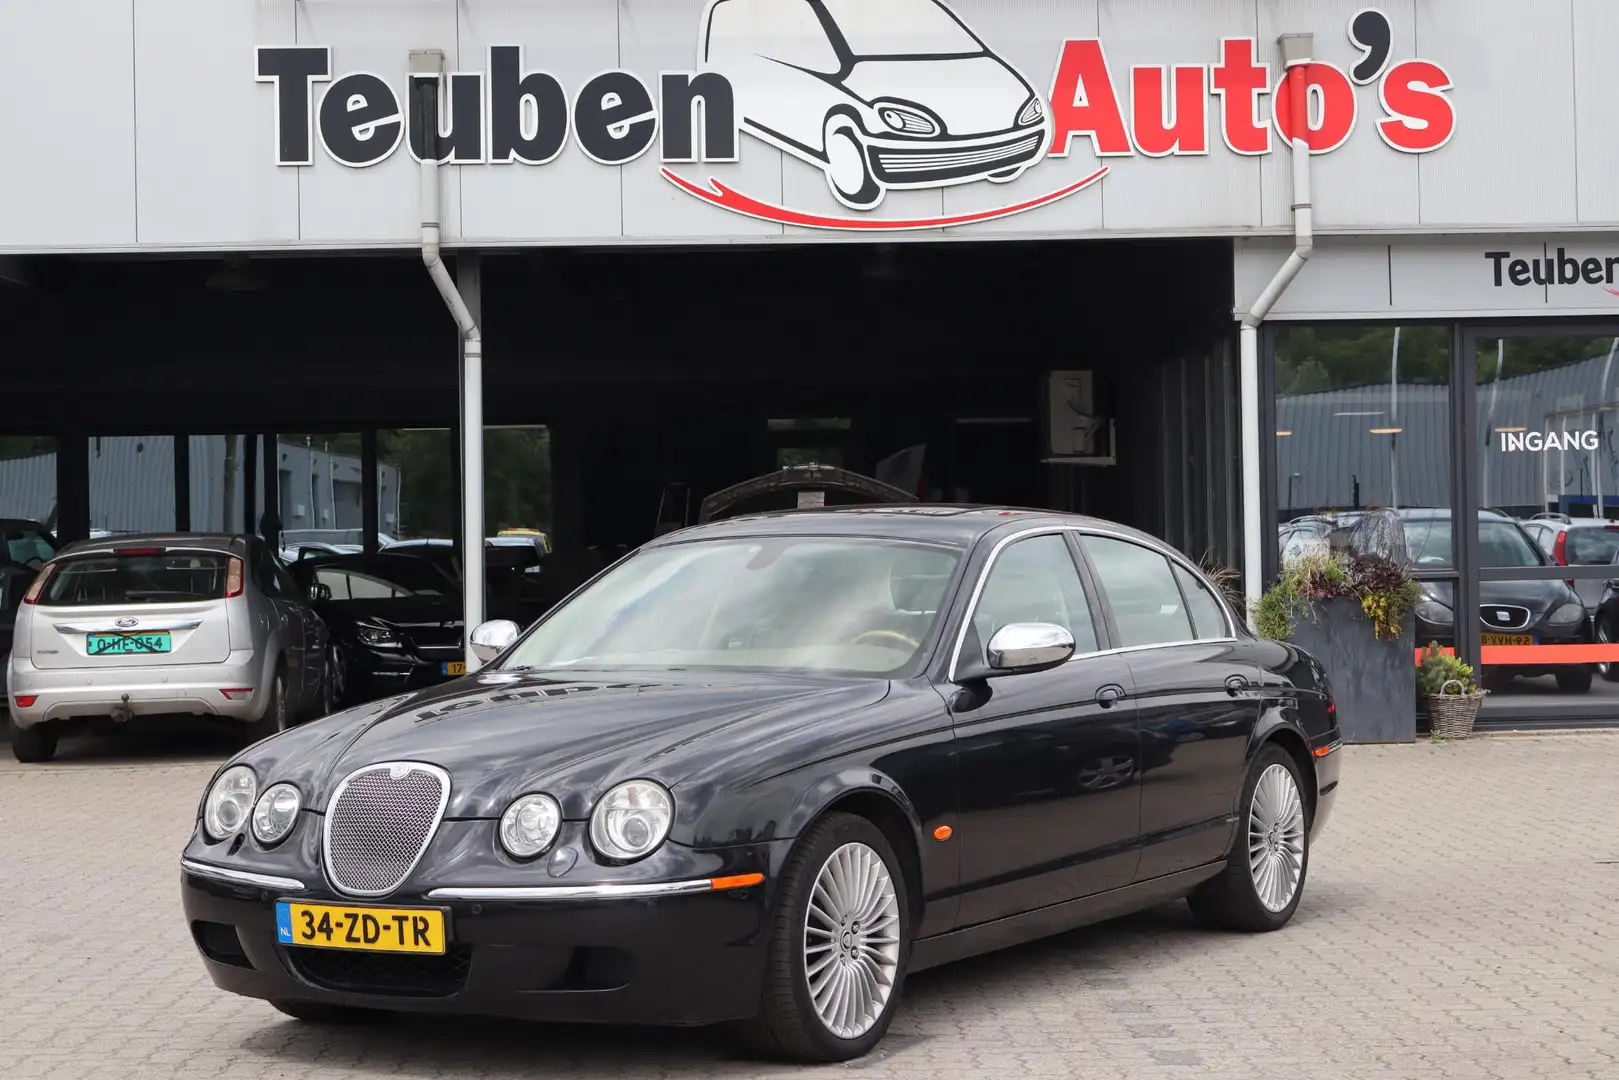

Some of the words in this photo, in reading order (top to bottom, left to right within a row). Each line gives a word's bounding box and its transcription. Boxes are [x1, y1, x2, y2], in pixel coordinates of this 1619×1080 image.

[255, 45, 739, 166] Teuben
[1049, 8, 1456, 157] Auto's
[1501, 430, 1599, 452] INGANG
[280, 926, 291, 937] NL
[301, 909, 431, 947] 34-ZD-TR
